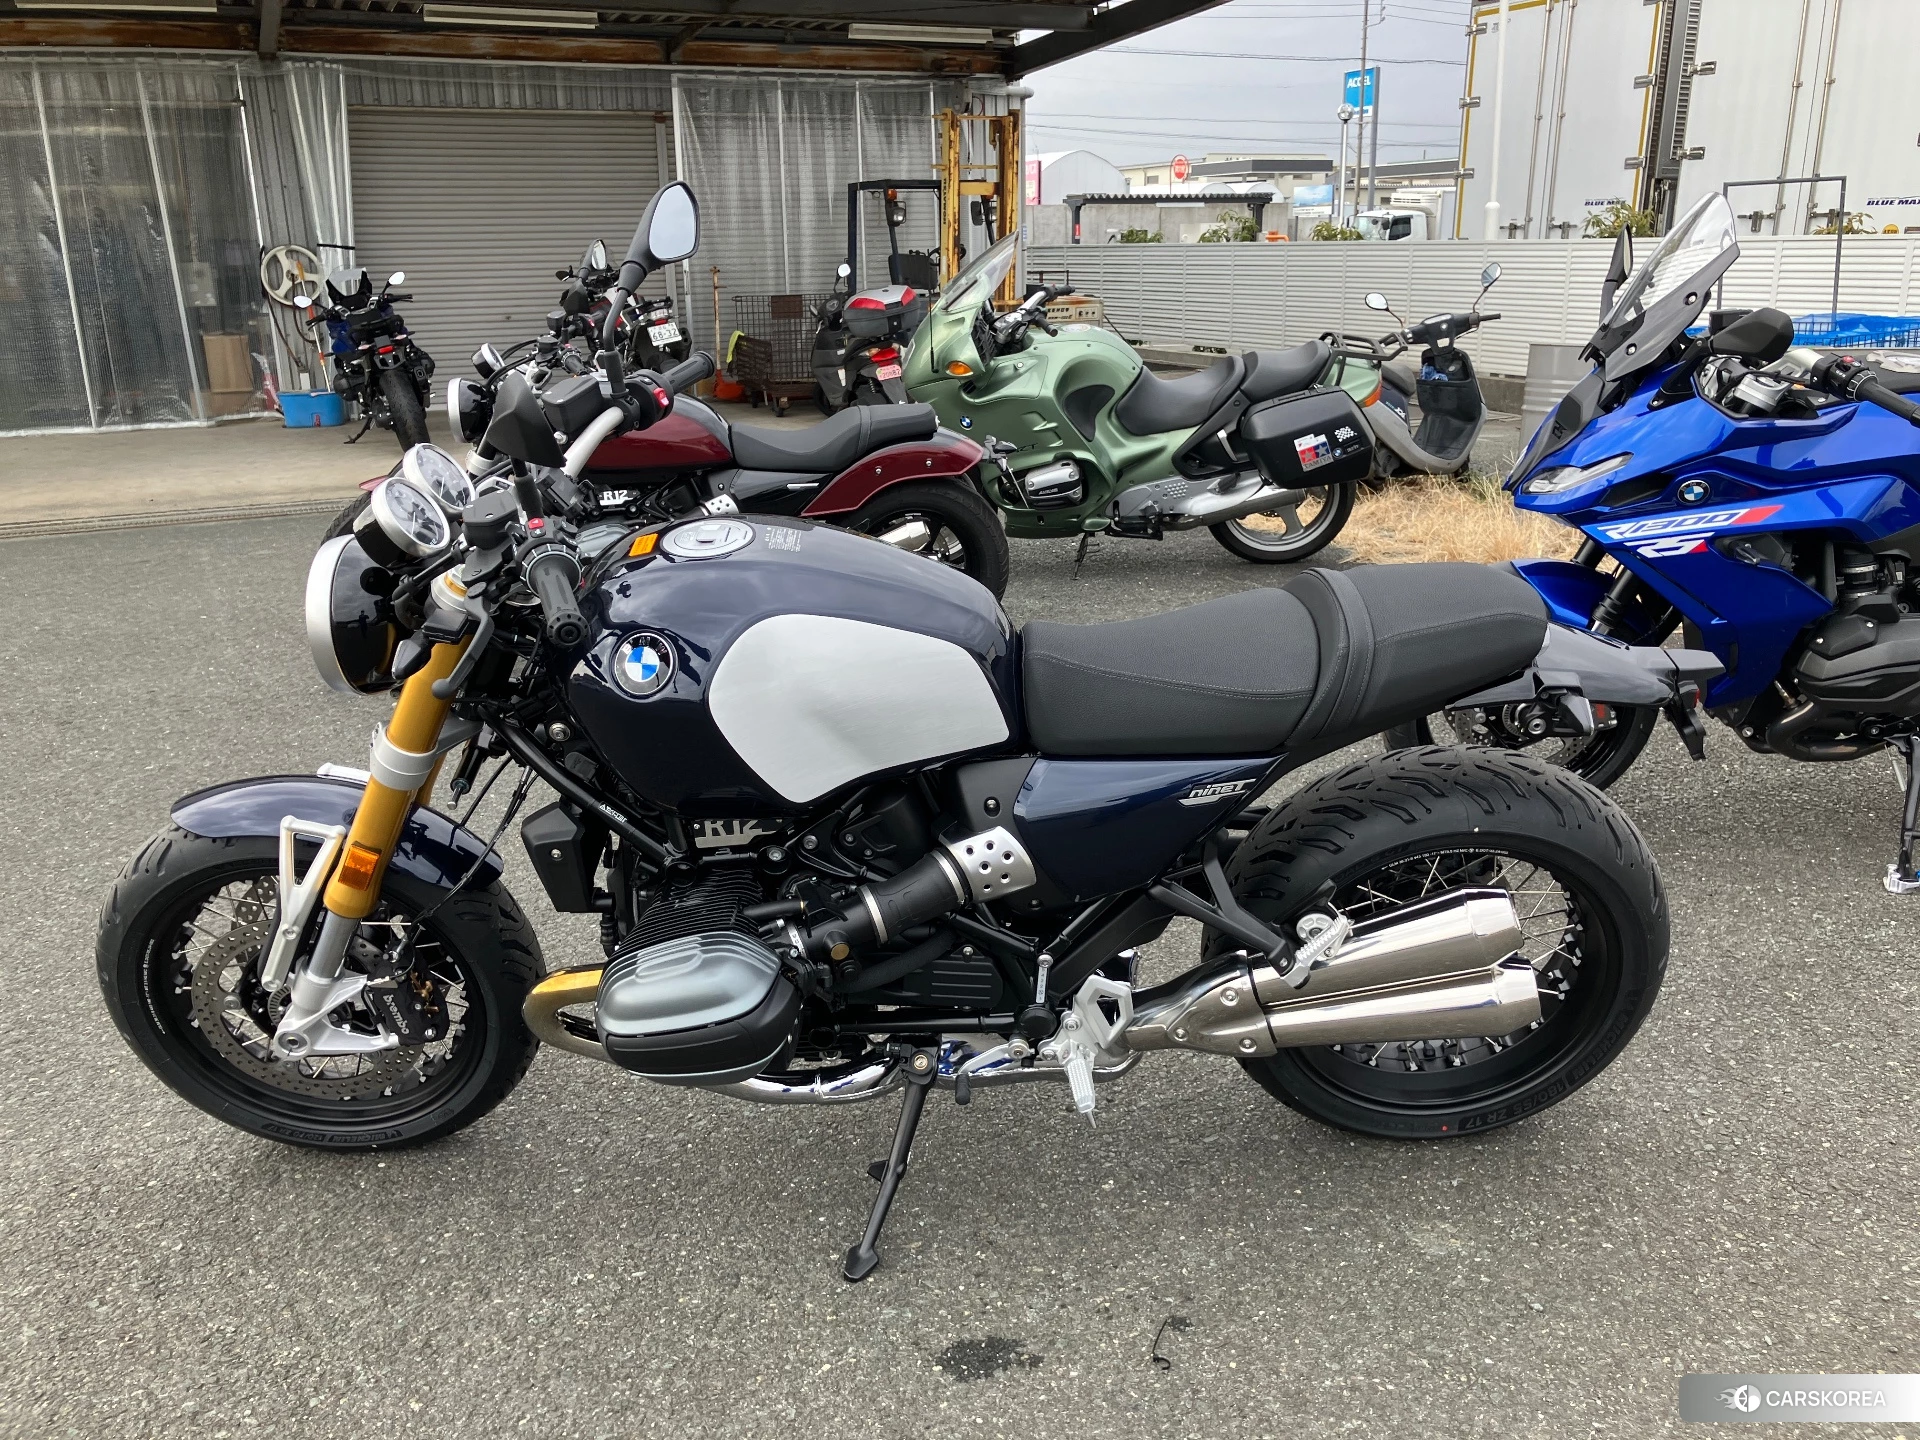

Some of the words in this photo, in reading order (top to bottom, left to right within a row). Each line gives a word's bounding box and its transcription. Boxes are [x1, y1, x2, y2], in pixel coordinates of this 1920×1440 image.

[1303, 455, 1332, 469] TAMIYA
[603, 490, 629, 501] R12
[703, 819, 763, 838] R12
[382, 994, 410, 1035] brembo
[1512, 1081, 1566, 1114] 180/55
[1464, 1115, 1483, 1130] 17
[1486, 1107, 1508, 1124] ZR
[332, 1132, 386, 1144] MICHELIN
